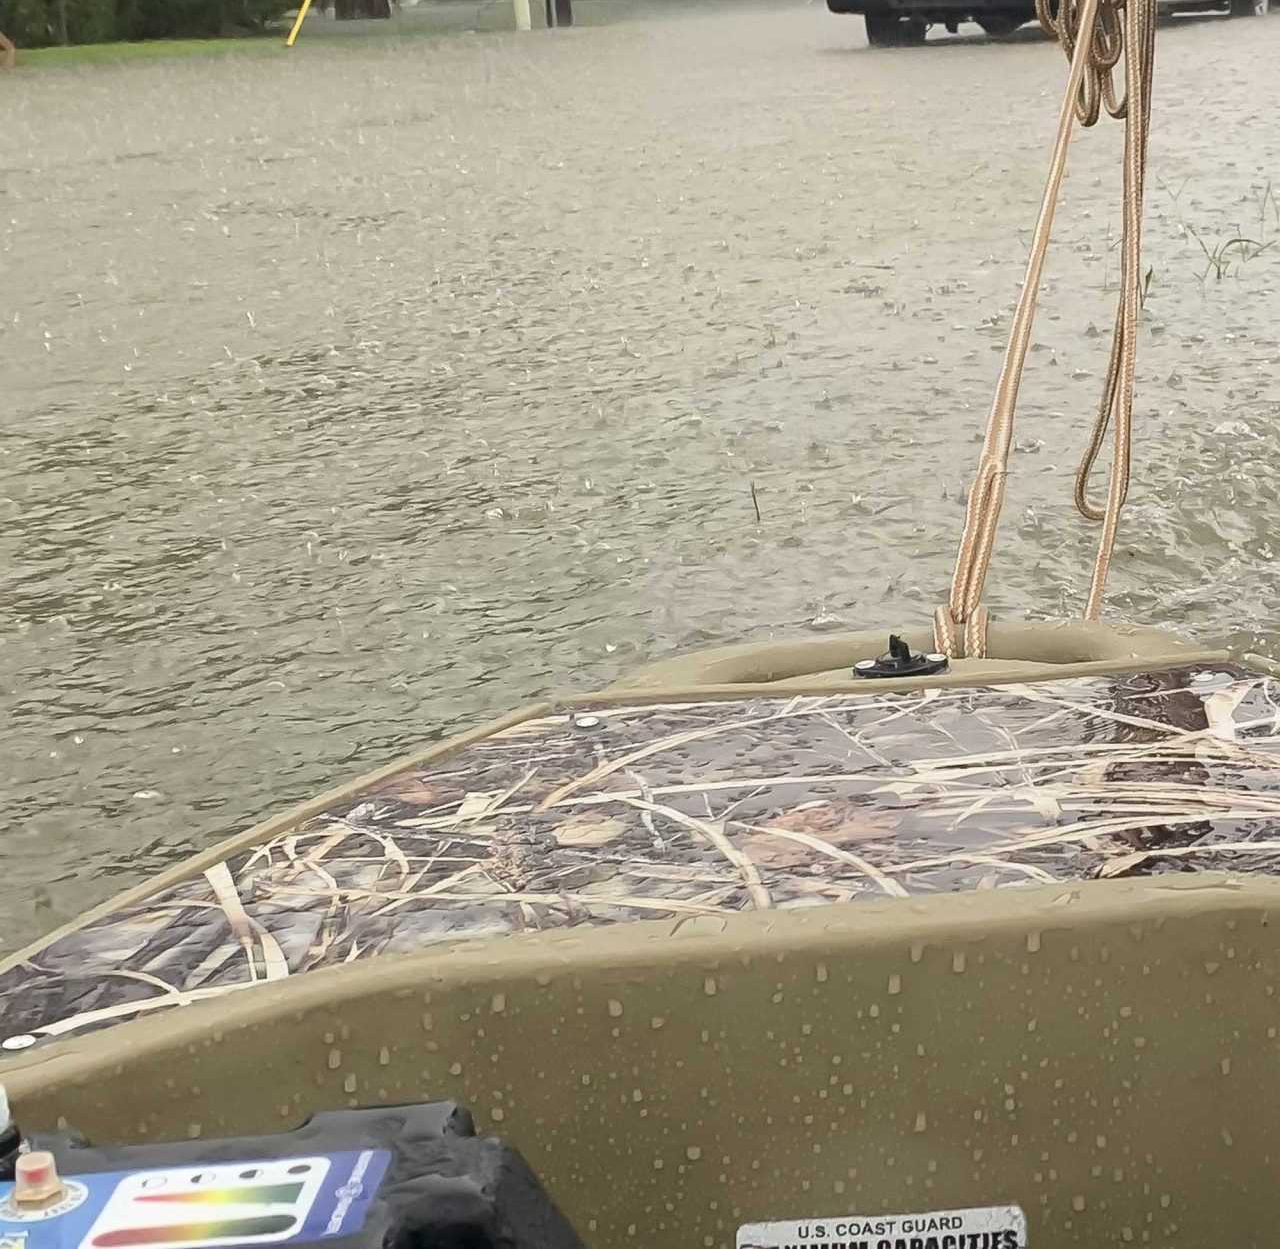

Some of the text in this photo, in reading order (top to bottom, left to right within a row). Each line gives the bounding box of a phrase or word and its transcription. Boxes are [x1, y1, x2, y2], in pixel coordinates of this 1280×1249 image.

[798, 1216, 963, 1239] U.S. COAST GUARD
